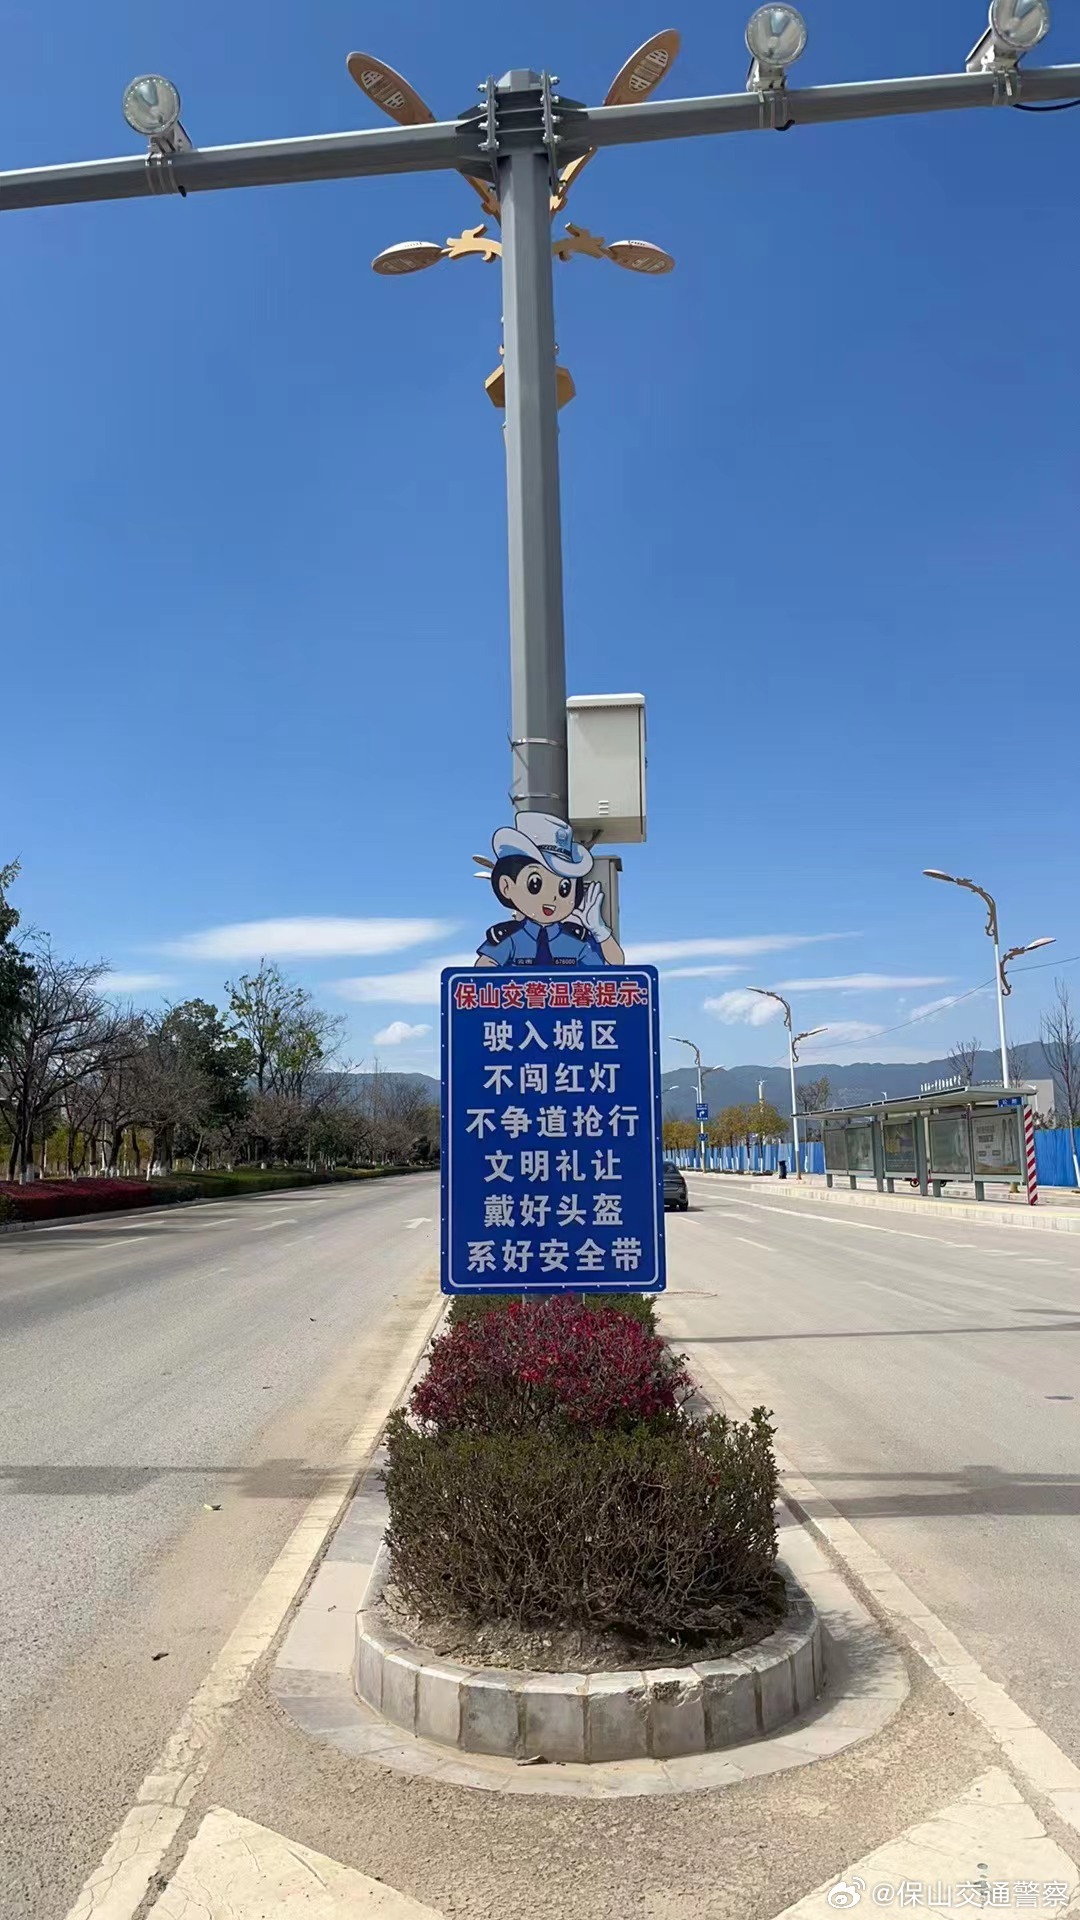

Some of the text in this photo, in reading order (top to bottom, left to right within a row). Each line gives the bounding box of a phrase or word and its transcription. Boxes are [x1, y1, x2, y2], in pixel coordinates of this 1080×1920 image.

[483, 1018, 619, 1051] 驶入城区
[484, 1062, 620, 1095] 不闯红灯
[466, 1105, 639, 1139] 不争道抢行
[484, 1149, 622, 1183] 文明礼让
[484, 1192, 623, 1228] 戴好头盔
[467, 1237, 642, 1273] 系好安全带
